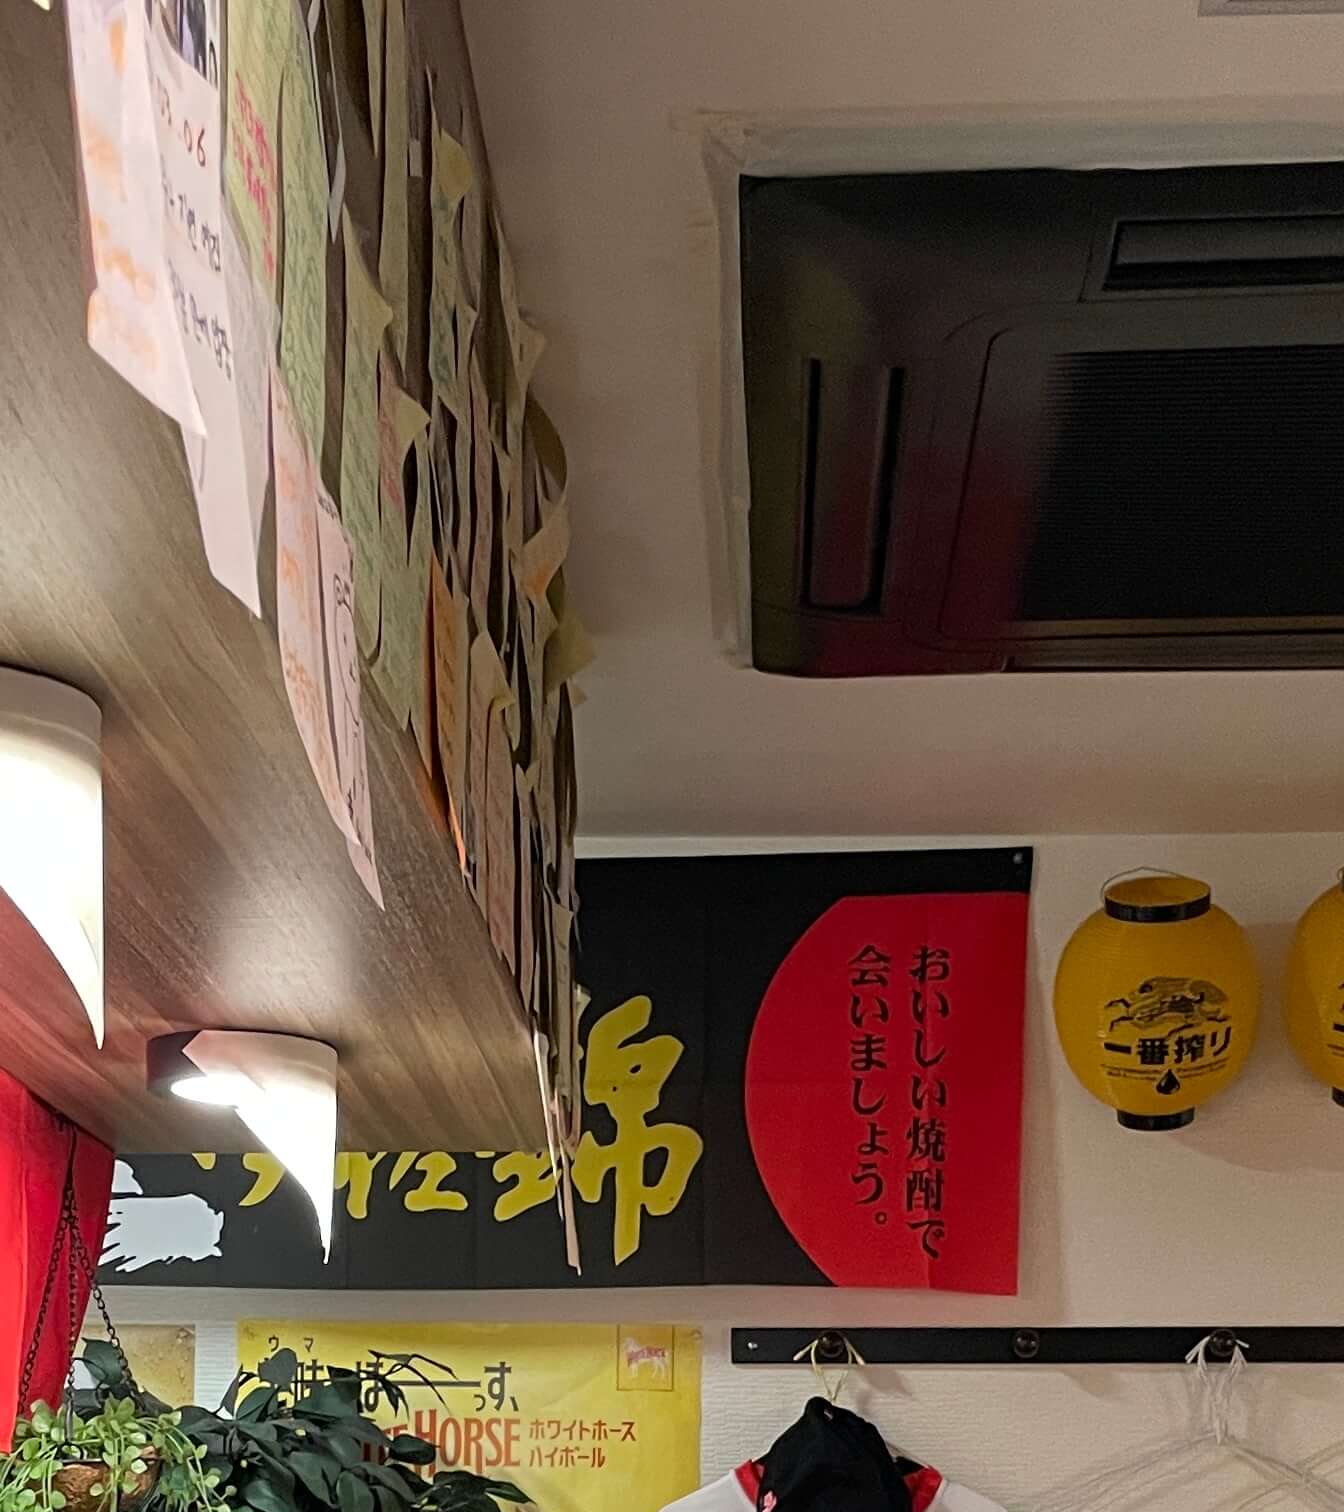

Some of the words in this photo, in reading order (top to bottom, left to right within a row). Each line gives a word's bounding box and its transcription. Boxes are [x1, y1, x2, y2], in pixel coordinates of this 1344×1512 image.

[1103, 1033, 1232, 1066] 一番搾り
[847, 944, 892, 1230] 会いましょう。
[904, 944, 952, 1260] おいしい焼酎で
[413, 1408, 522, 1479] HORSE
[528, 1418, 636, 1442] ホワイトホース
[529, 1447, 607, 1469] ハイボール
